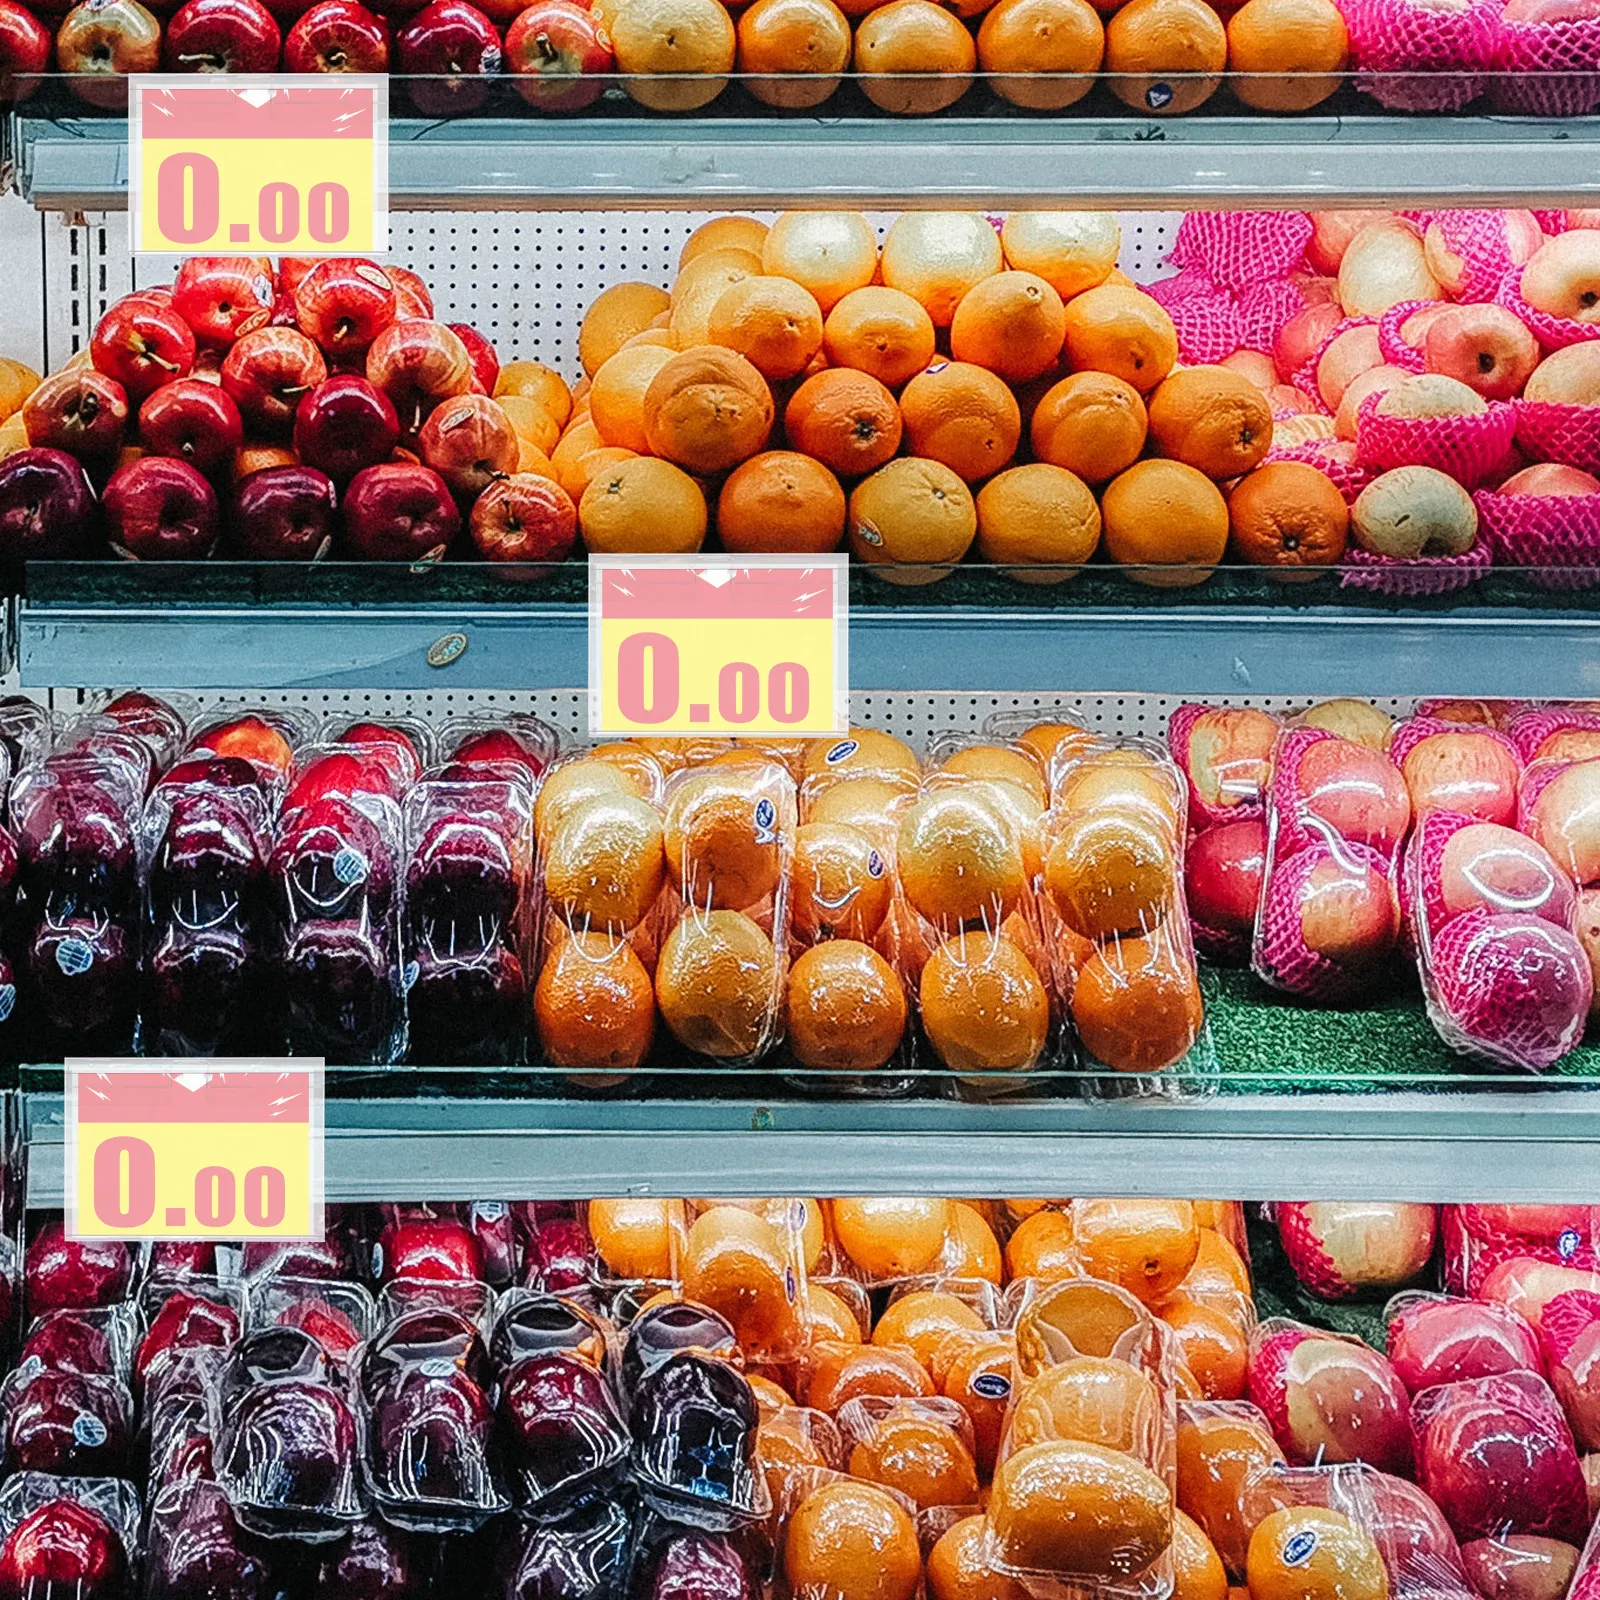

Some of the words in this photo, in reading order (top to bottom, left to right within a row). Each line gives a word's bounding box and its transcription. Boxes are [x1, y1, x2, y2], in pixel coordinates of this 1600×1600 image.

[158, 152, 349, 244] 0.00
[618, 632, 809, 724] 0.00
[94, 1136, 285, 1228] 0.00
